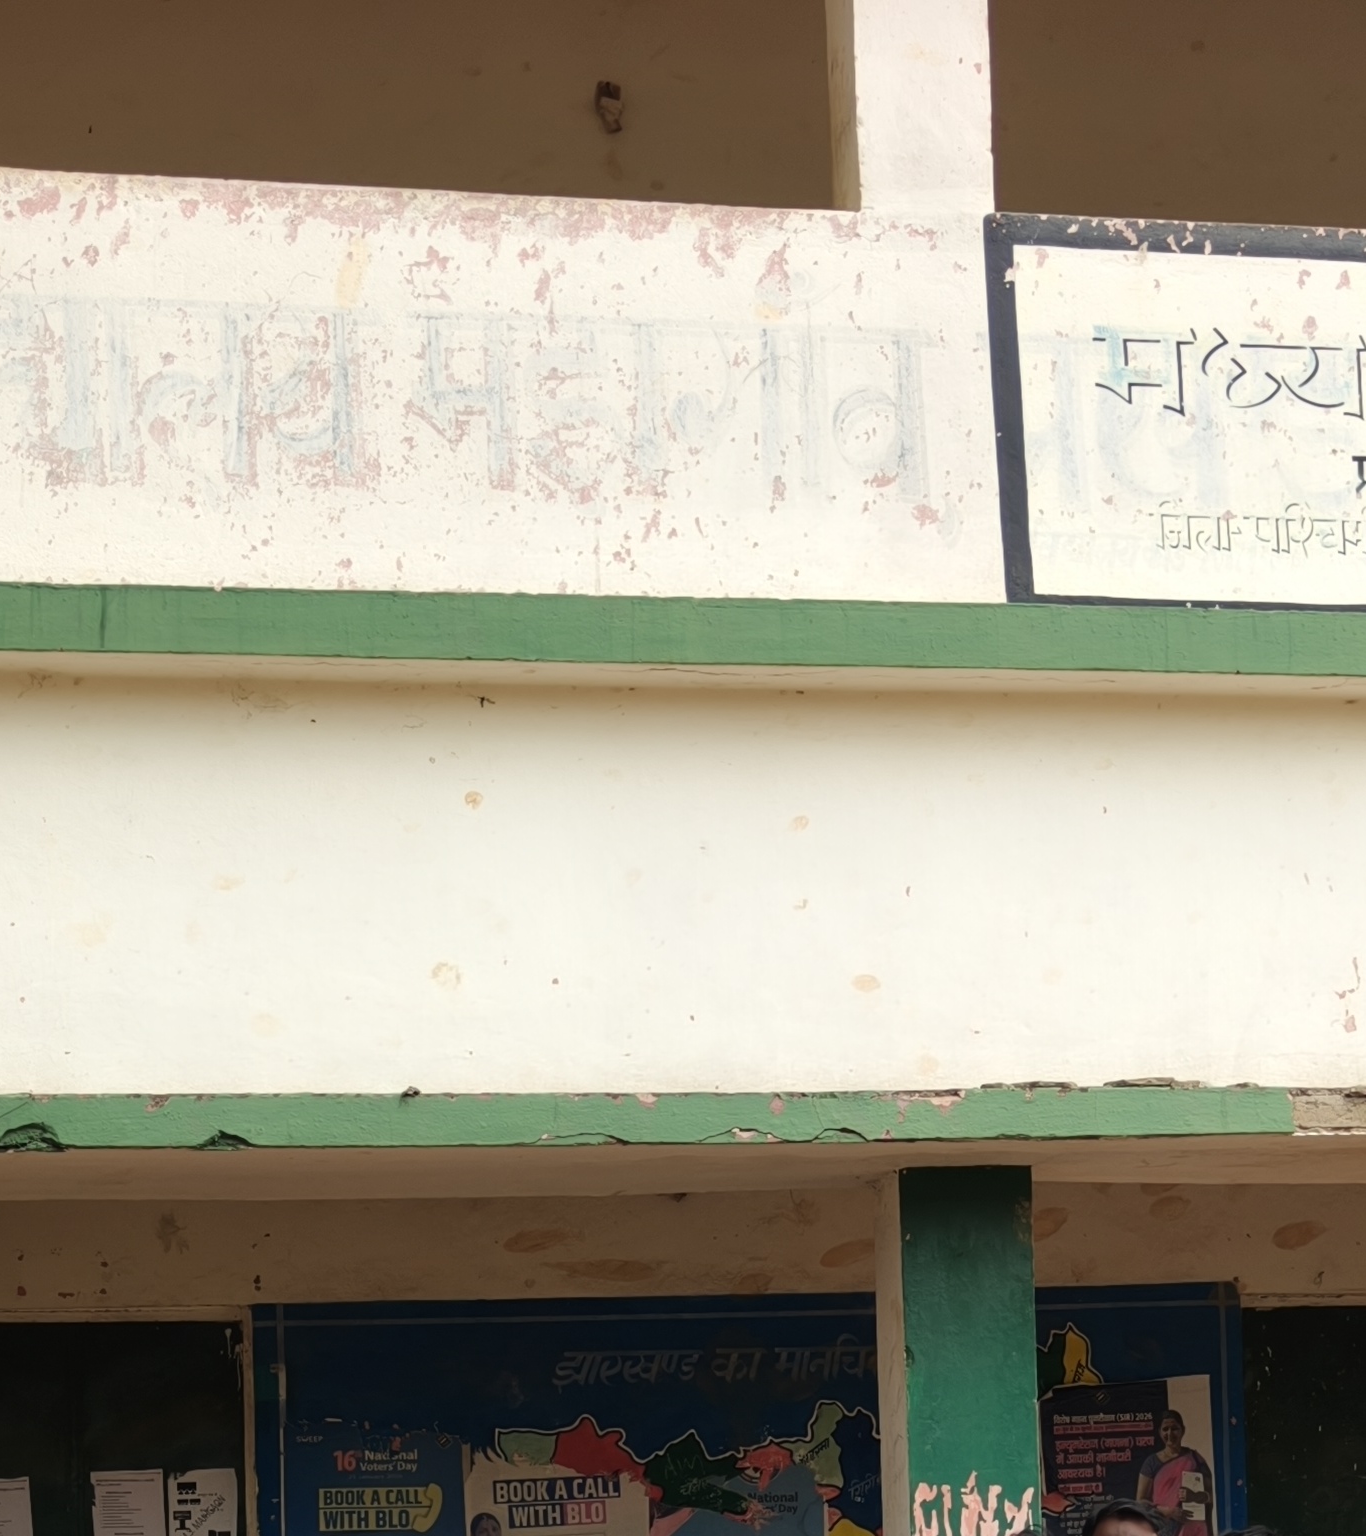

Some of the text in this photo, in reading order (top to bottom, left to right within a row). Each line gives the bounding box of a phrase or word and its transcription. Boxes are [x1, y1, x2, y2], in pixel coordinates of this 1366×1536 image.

[554, 1333, 877, 1394] झारखण्ड का मानचि
[1135, 1412, 1153, 1421] 2026
[397, 1461, 418, 1473] Day
[323, 1488, 423, 1506] BOOK A CALL
[495, 1476, 620, 1503] BOOK A CALL
[323, 1509, 410, 1529] WITH BLO
[512, 1502, 605, 1527] WITH BLO
[778, 1504, 798, 1515] Day
